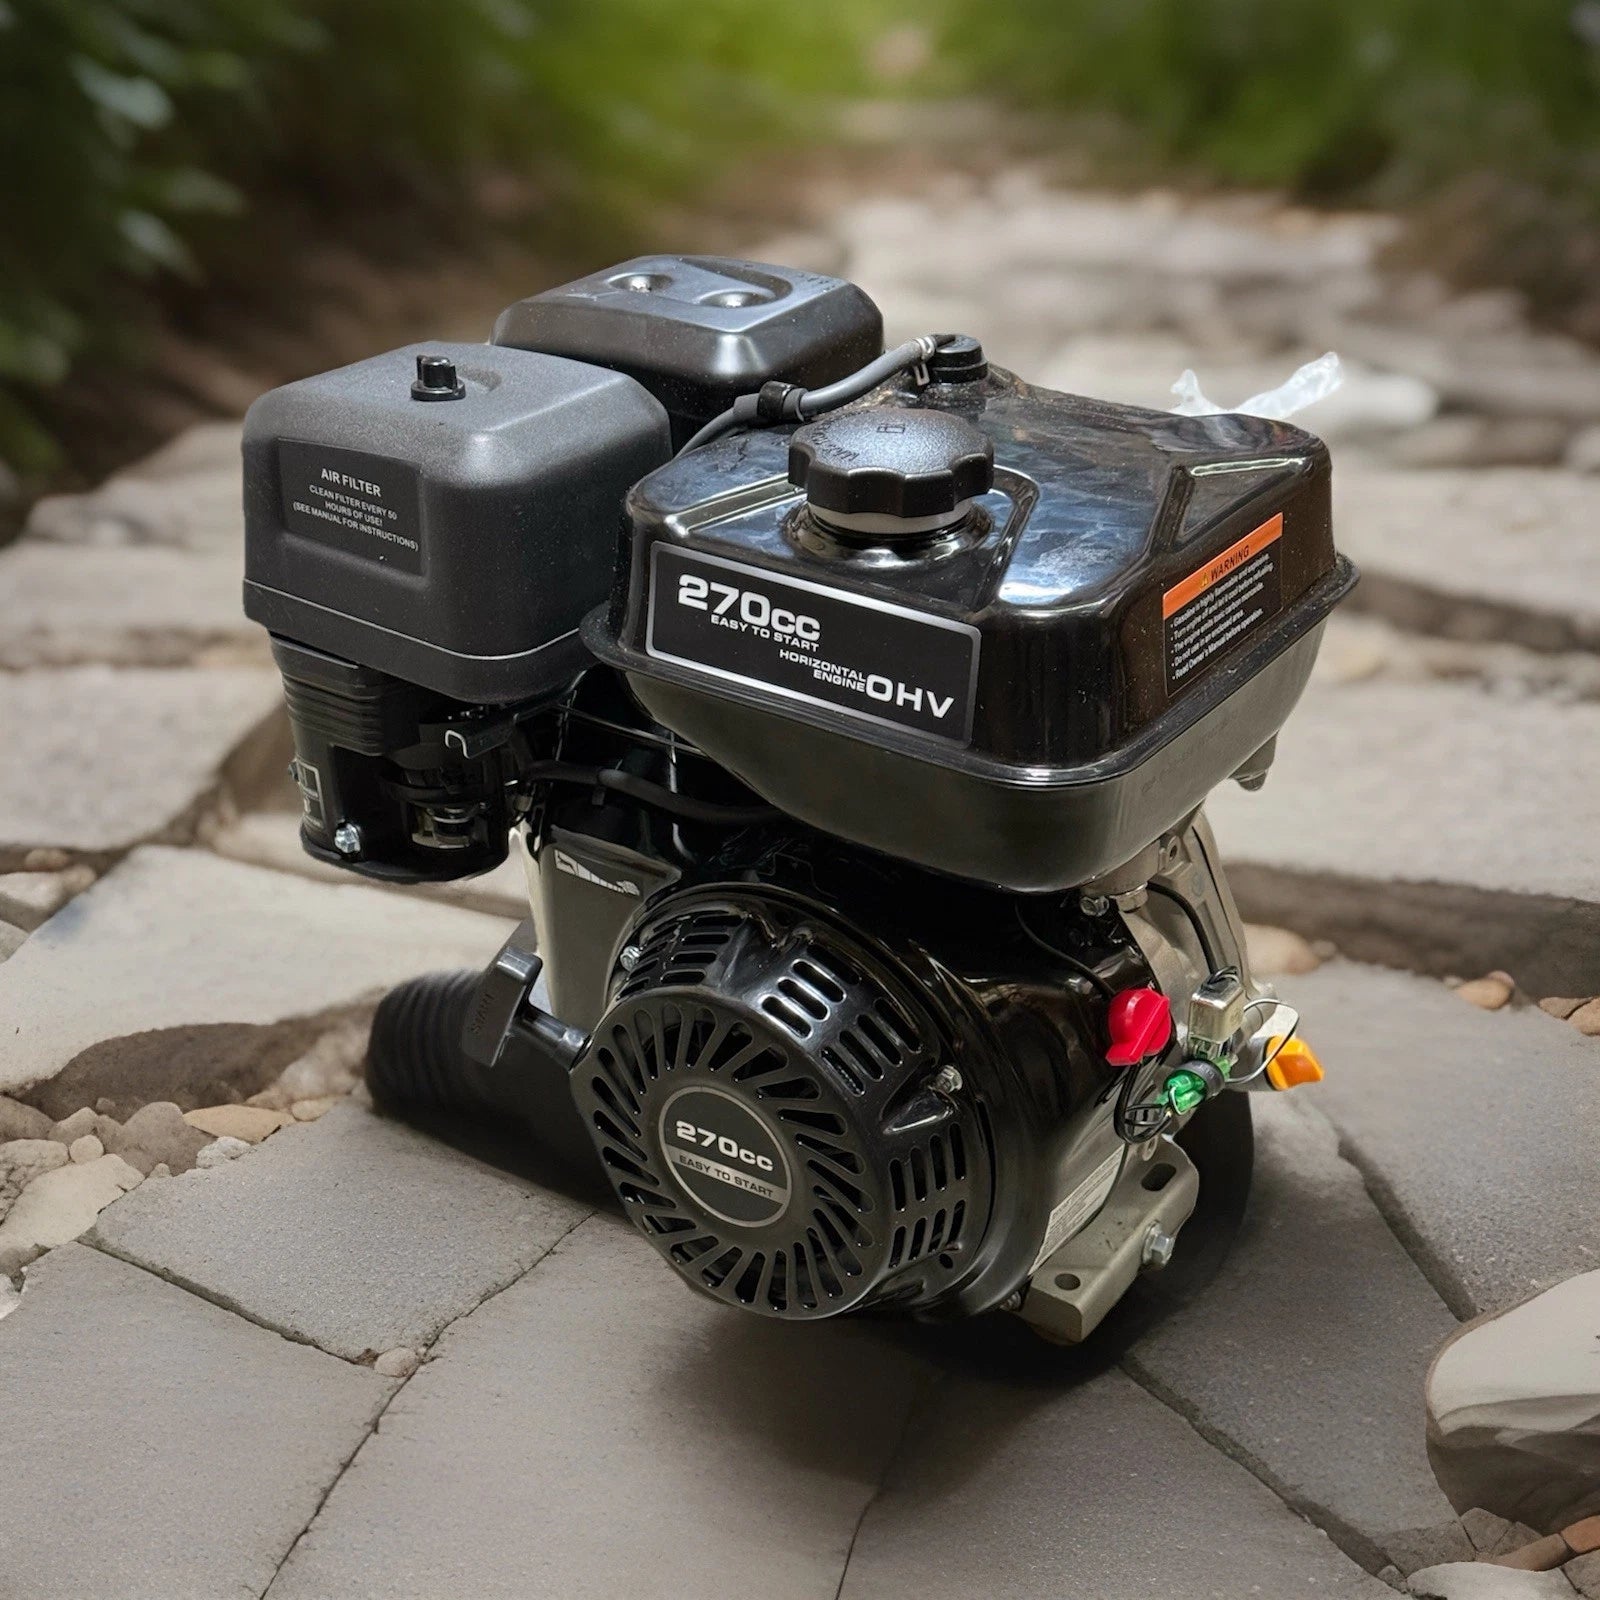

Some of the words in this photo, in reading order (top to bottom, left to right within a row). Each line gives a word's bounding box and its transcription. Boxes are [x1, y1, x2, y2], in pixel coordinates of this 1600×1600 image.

[321, 468, 340, 484] AIR
[342, 474, 381, 497] FILTER
[309, 485, 335, 499] CLEAN
[335, 493, 361, 508] FILTER
[361, 501, 387, 516] EVERY
[387, 510, 398, 520] 50
[325, 501, 352, 517] HOURS
[353, 511, 364, 519] OF
[293, 501, 311, 514] (SEE
[311, 507, 342, 524] MANUAL
[342, 517, 359, 530] FOR
[359, 523, 419, 552] INSTRUCTIONS)
[1210, 545, 1250, 581] WARNING
[711, 614, 748, 632] EASY
[752, 625, 770, 639] TO
[773, 632, 820, 653] START
[779, 649, 866, 683] HORIZONTAL
[813, 669, 866, 693] ENGINE
[865, 673, 955, 719] OHV
[680, 1155, 711, 1173] EASY
[714, 1168, 731, 1181] TO
[734, 1175, 774, 1199] START
